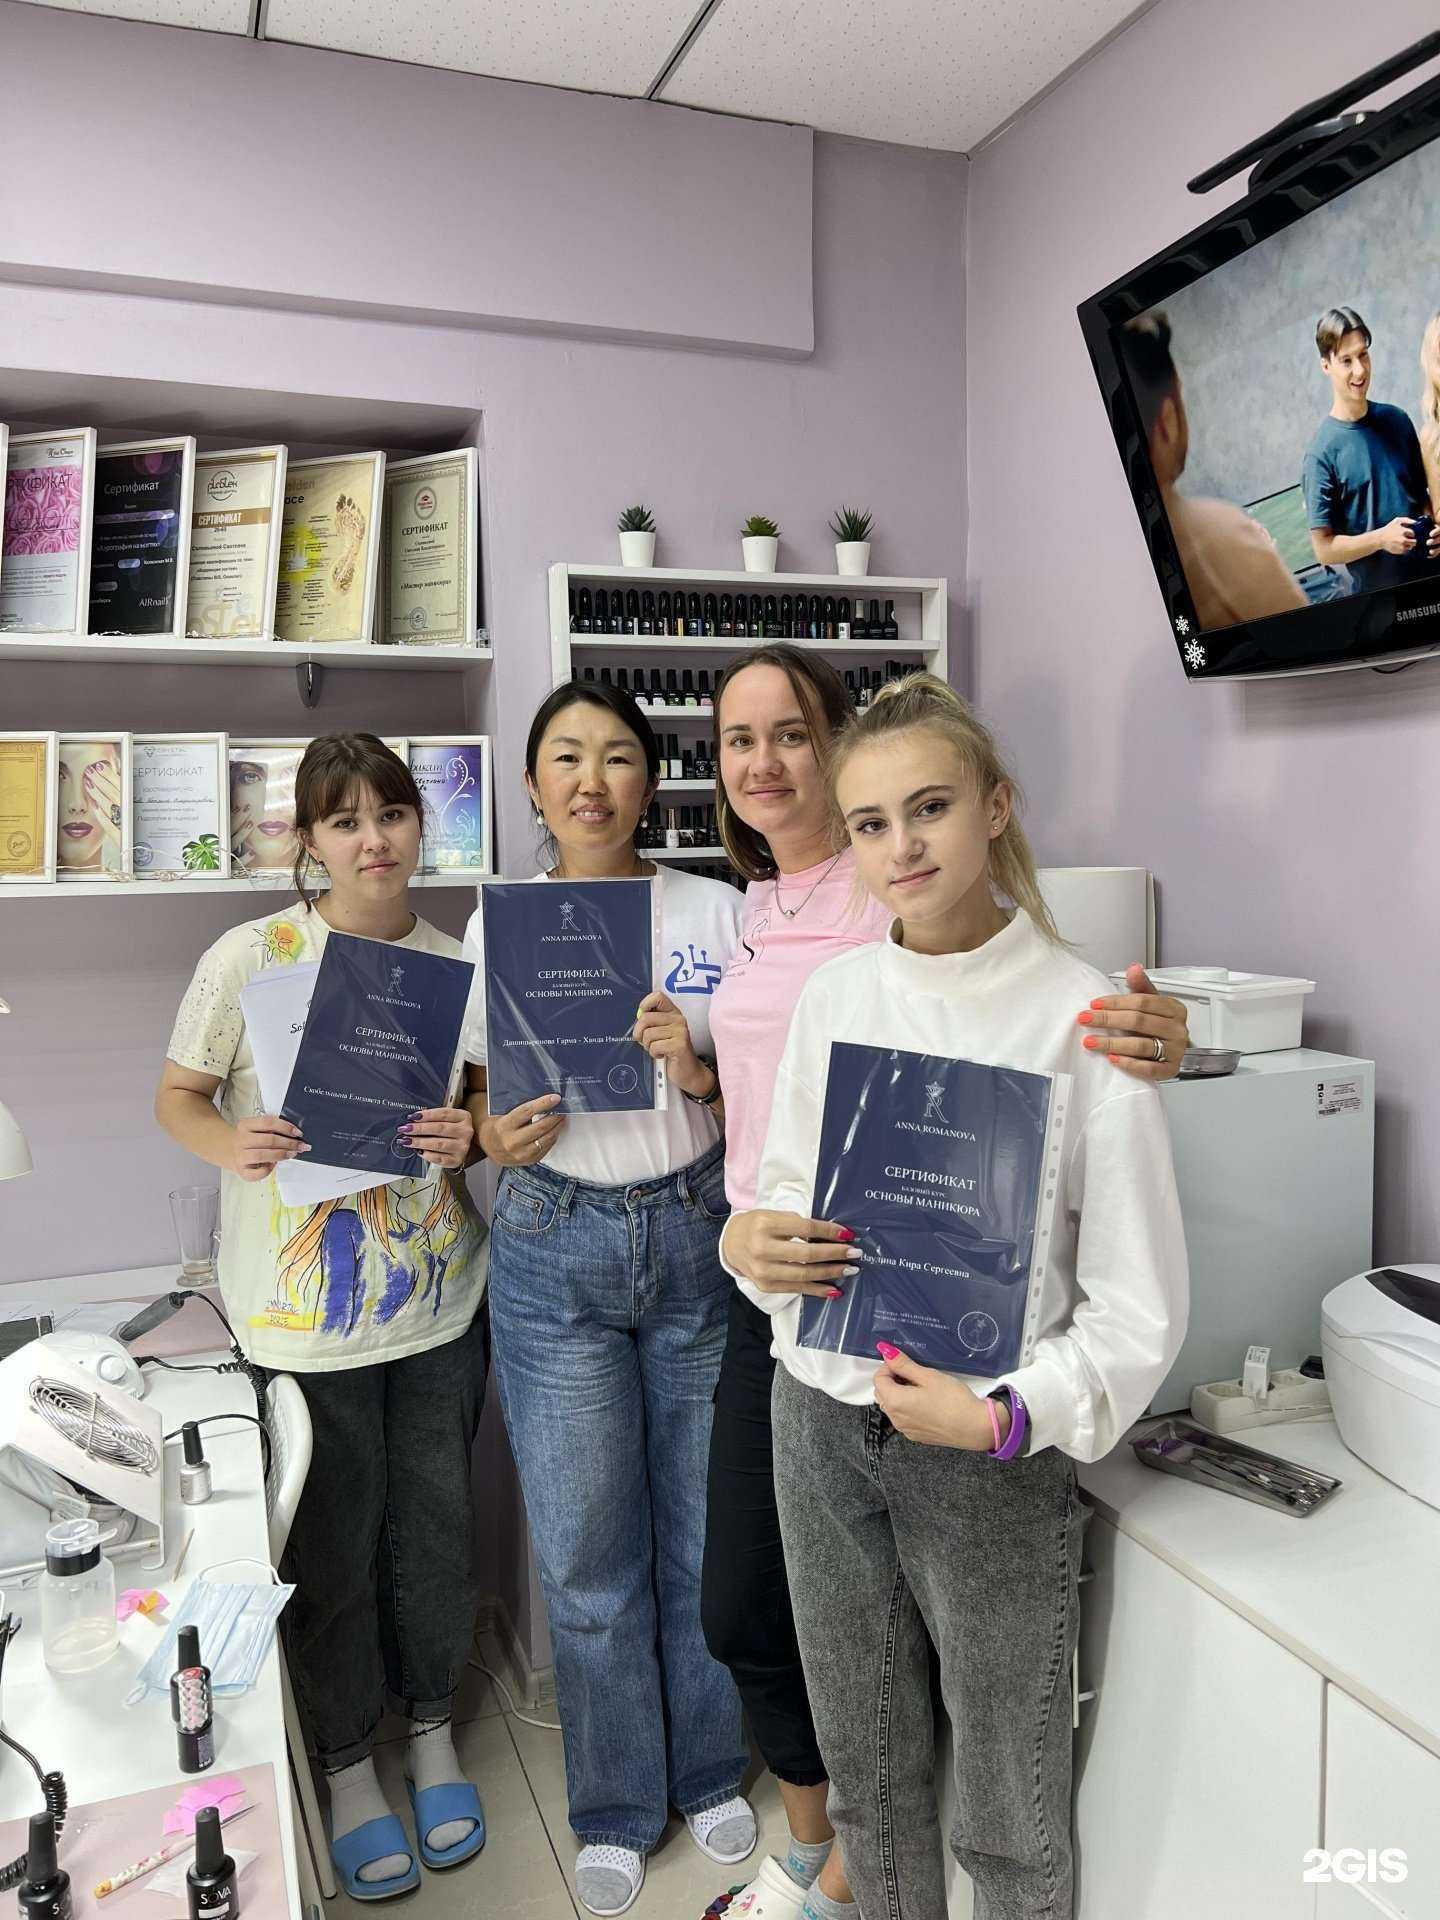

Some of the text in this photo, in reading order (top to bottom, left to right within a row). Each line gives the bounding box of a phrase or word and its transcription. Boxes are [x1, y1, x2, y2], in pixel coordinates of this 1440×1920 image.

[103, 481, 160, 497] Сертификат
[198, 512, 242, 526] СЕРТИФИКАТ
[401, 521, 449, 537] СЕРТИФИКАТ
[538, 968, 607, 979] СЕРТИФИКАТ
[525, 988, 613, 998] ОСНОВЫ МАНИКЮРА
[355, 1026, 418, 1045] СЕРТИФИКАТ
[556, 1037, 577, 1046] Гарма
[583, 1036, 604, 1044] Ханда
[339, 1043, 418, 1064] ОСНОВЫ МАНИКЮРА
[895, 1120, 977, 1142] ANNA ROMANOVA
[884, 1165, 977, 1191] СЕРТИФИКАТ
[865, 1189, 980, 1217] ОСНОВЫ МАНИКЮРА
[898, 1257, 922, 1271] Кира
[923, 1262, 970, 1279] Сергеевна
[200, 1886, 232, 1905] SOVA
